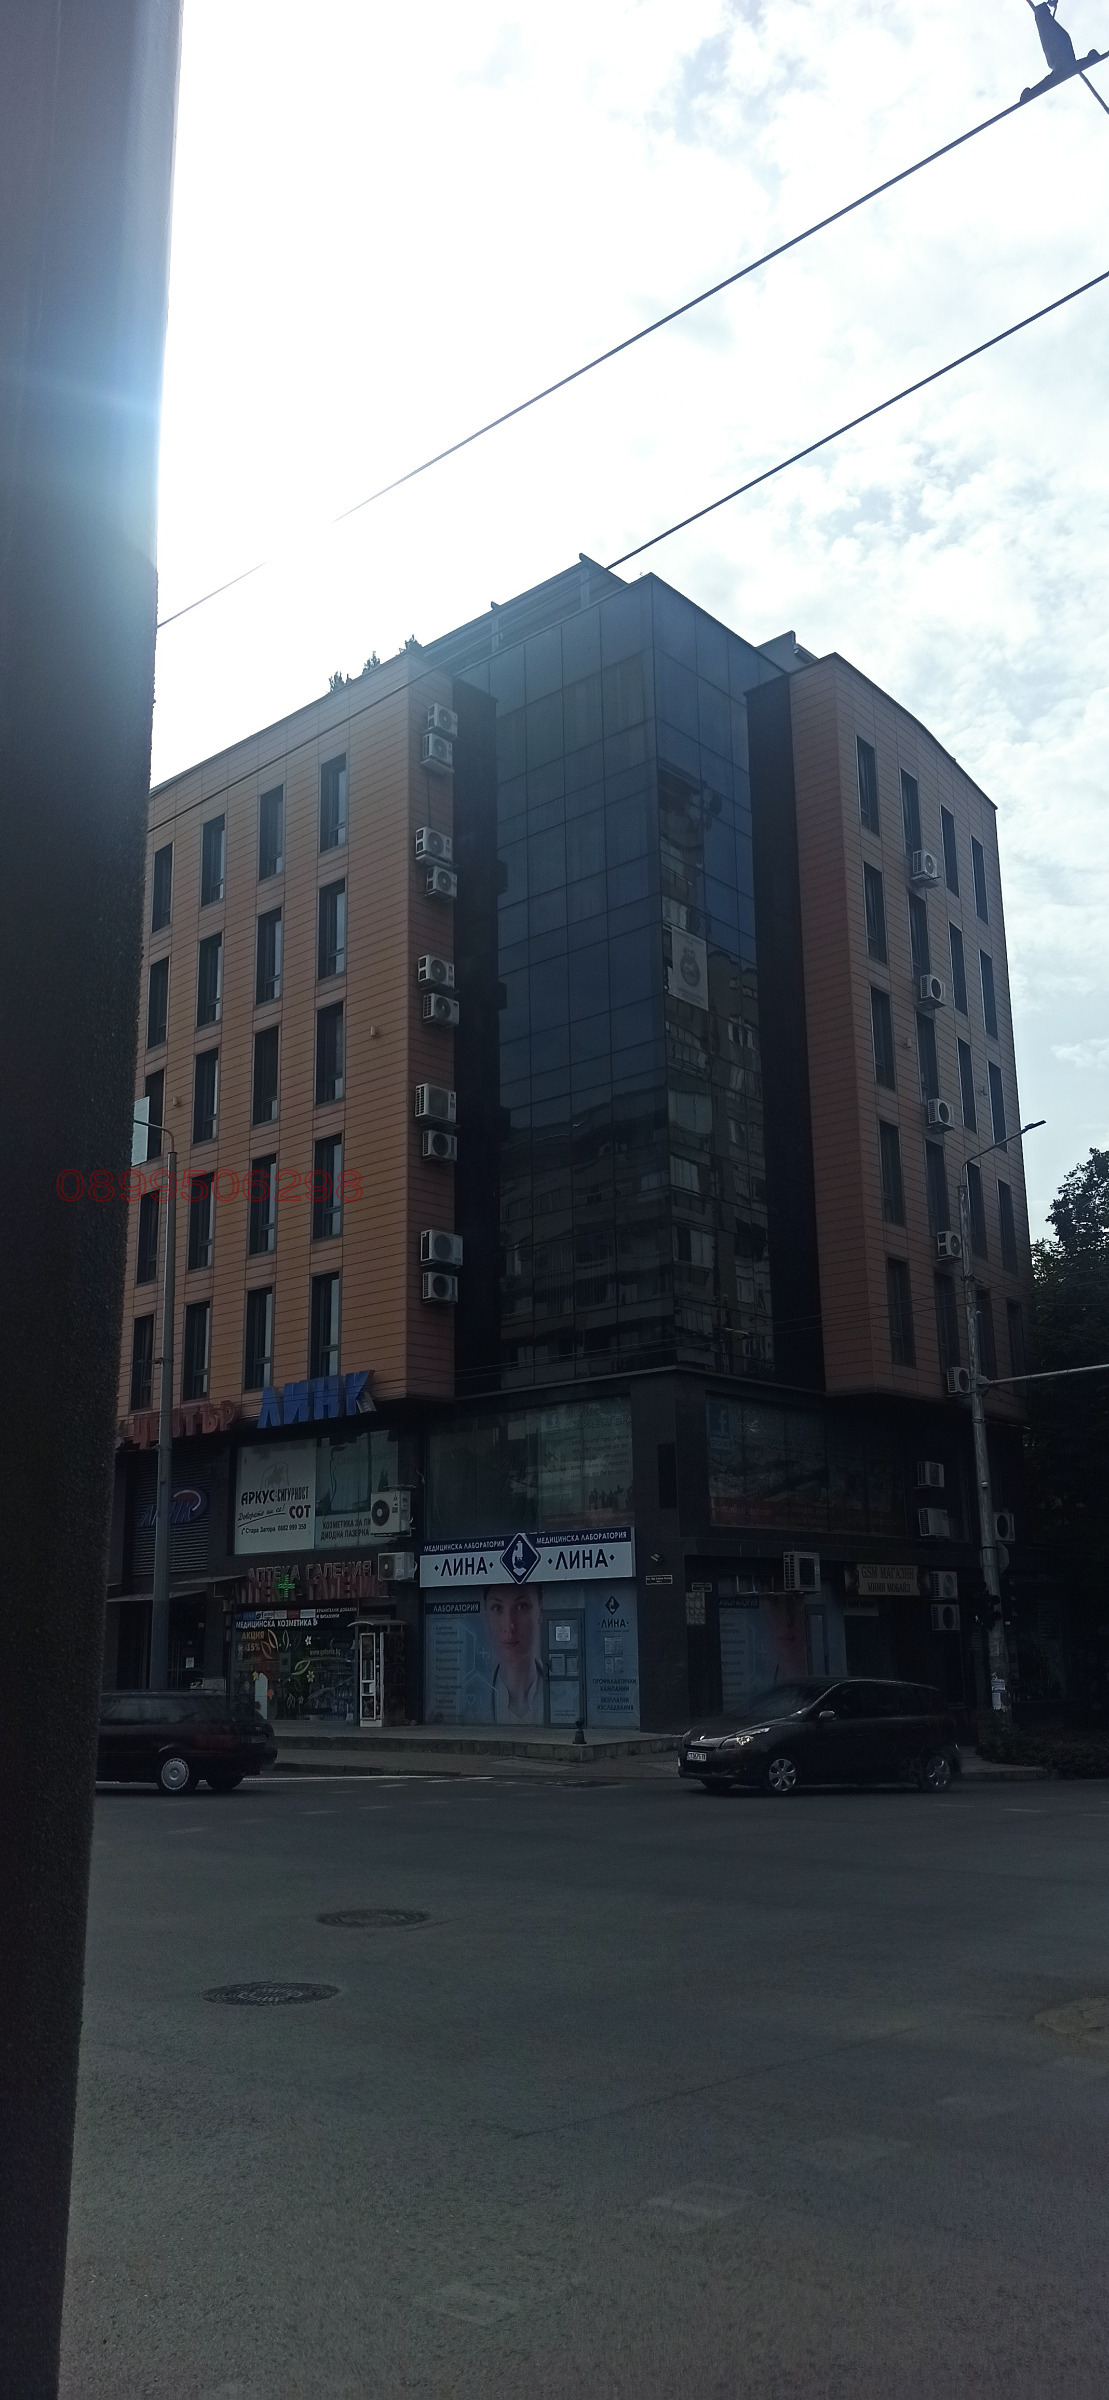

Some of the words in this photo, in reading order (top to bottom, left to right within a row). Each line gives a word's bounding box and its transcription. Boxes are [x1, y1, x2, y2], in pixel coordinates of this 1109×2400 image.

[257, 1369, 377, 1429] ЛИНК
[289, 1504, 311, 1519] СОТ
[535, 1535, 580, 1545] МЕДИЦИНСКА
[581, 1531, 627, 1541] ЛАБОРАТОРИЯ
[423, 1544, 463, 1553] МЕДИЦИНСКА
[463, 1540, 505, 1550] ЛАБОРАТОРИЯ
[555, 1549, 609, 1570] ЛИНА
[440, 1557, 488, 1577] ЛИНА
[862, 1566, 878, 1578] GSM
[433, 1603, 479, 1613] ЛАБОРАТОРИЯ
[236, 1620, 276, 1629] МЕДИЦИНСКА
[277, 1618, 312, 1627] КОЗМЕТИКА
[600, 1619, 626, 1628] ЛИНА
[241, 1631, 265, 1640] АКЦИЯ
